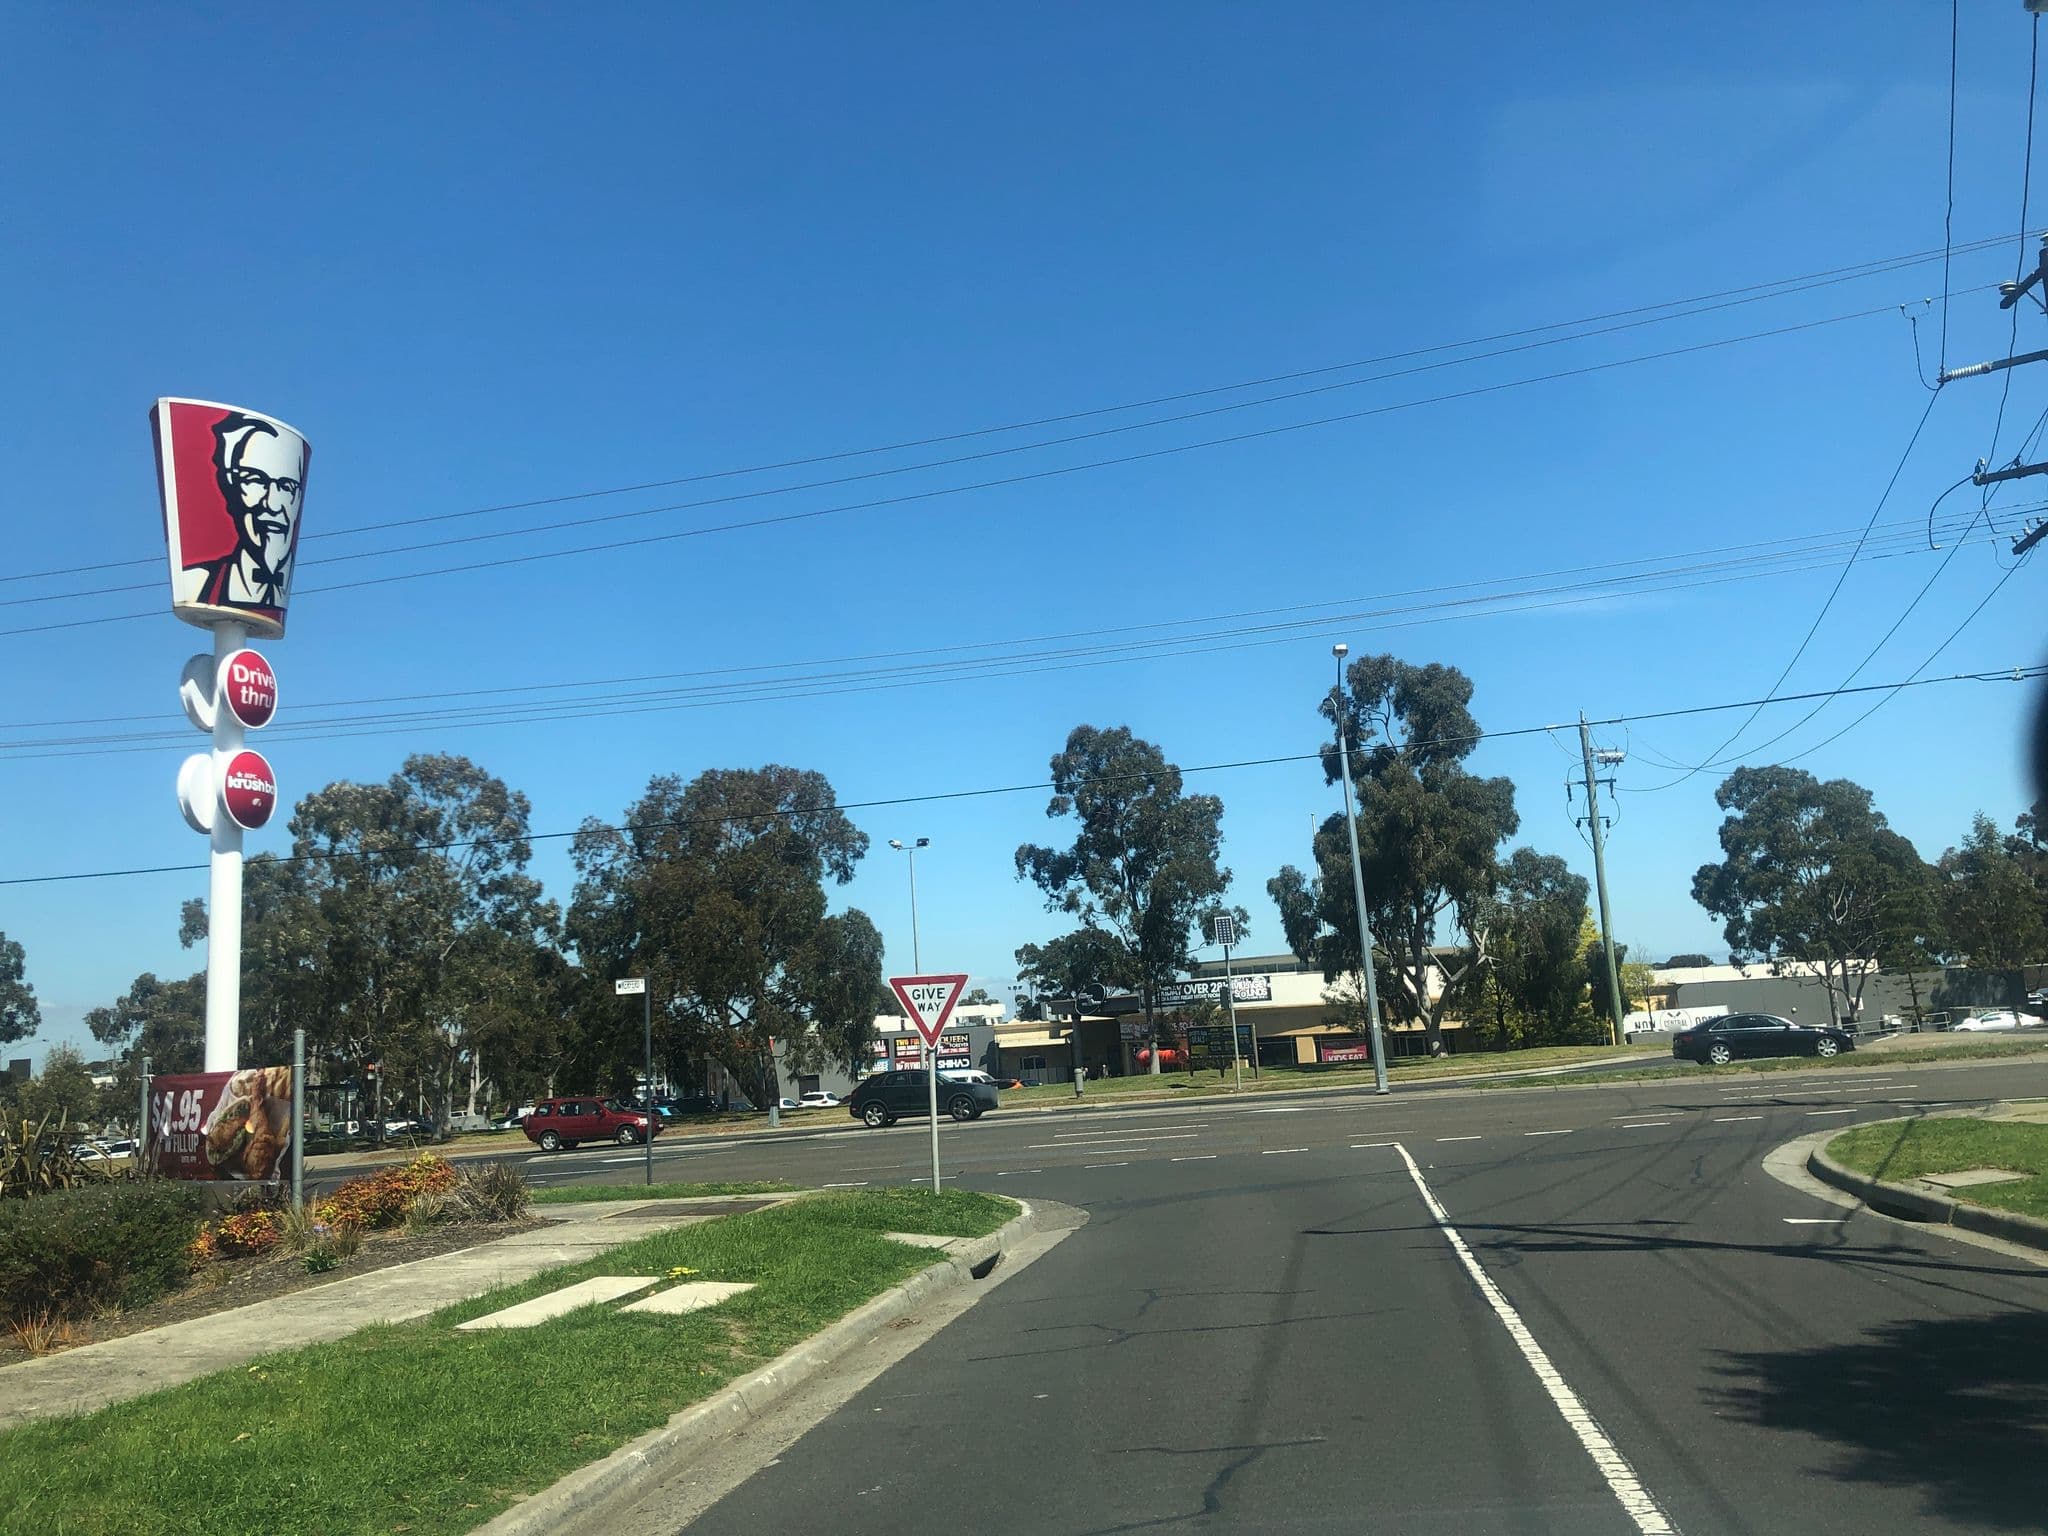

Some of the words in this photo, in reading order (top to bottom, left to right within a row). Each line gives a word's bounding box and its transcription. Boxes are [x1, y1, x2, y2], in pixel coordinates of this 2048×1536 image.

[232, 664, 274, 689] Drive
[240, 685, 272, 708] thru
[912, 987, 946, 1000] GIVE
[1184, 983, 1208, 994] OVER
[918, 1002, 942, 1012] WAY
[1635, 1020, 1656, 1029] NOW
[937, 1058, 970, 1069] SHIHAD
[173, 1134, 188, 1153] FILL
[188, 1133, 199, 1153] UP
